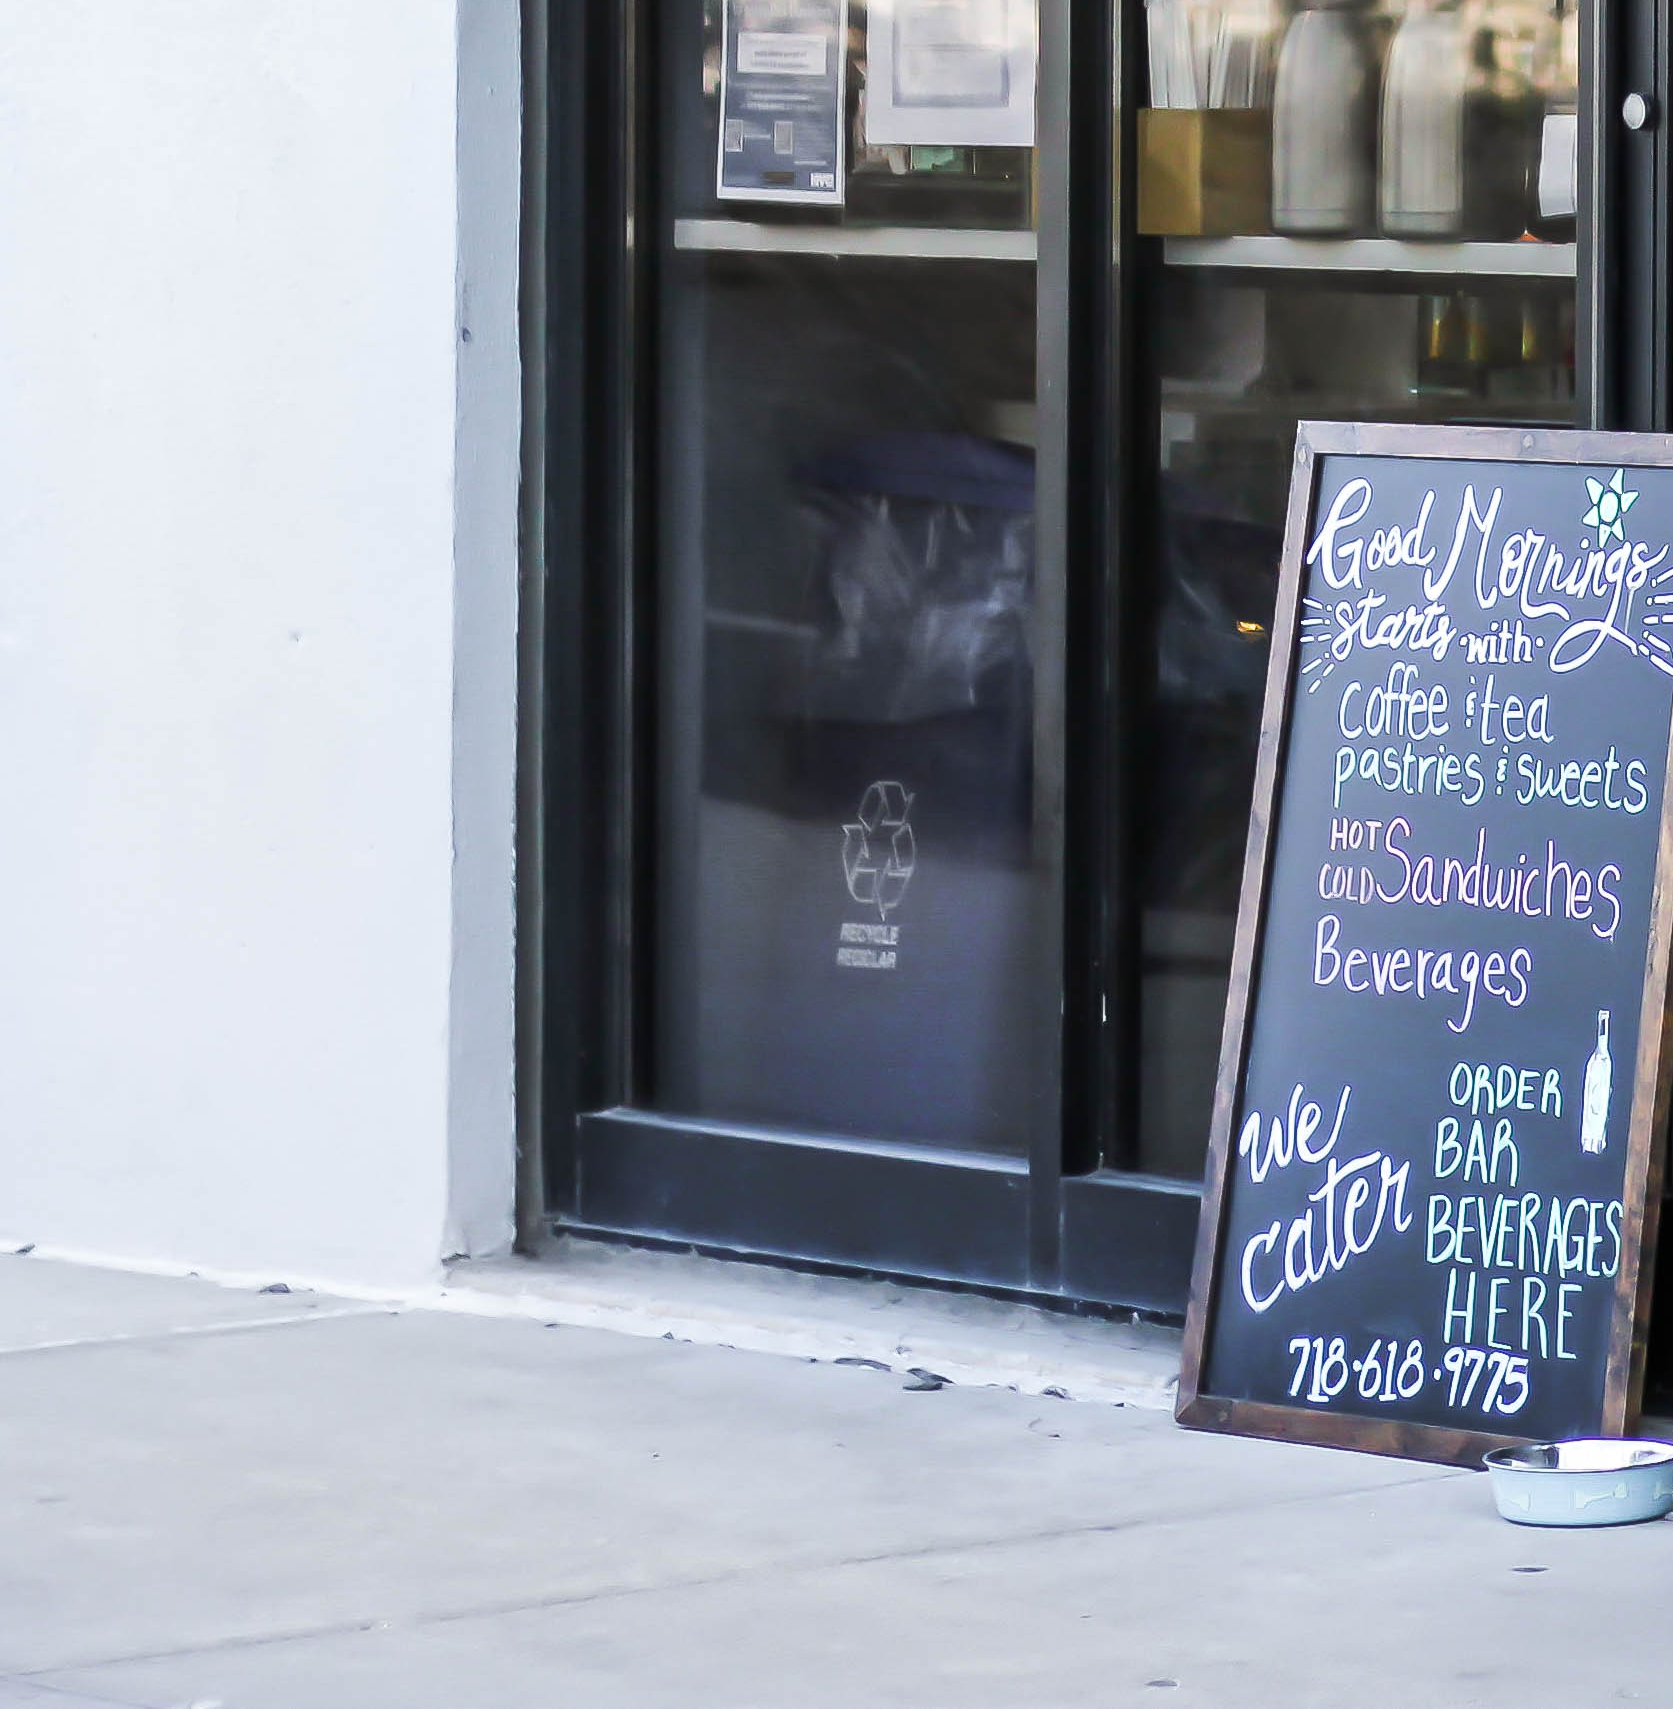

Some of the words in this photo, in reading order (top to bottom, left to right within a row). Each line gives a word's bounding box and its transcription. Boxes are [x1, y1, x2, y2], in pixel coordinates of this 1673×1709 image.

[1307, 478, 1436, 590] Good
[1424, 485, 1671, 673] Mornings
[1481, 675, 1553, 746] tea
[1333, 745, 1485, 808] pastries
[1517, 746, 1648, 814] sweets
[1330, 817, 1383, 852] HOT
[1318, 863, 1373, 904] COLD
[1376, 816, 1621, 940] Sandwiches
[1314, 914, 1532, 1033] Beverages
[1449, 1062, 1562, 1118] ORDER
[1435, 1116, 1518, 1187] BAR
[1241, 1150, 1413, 1313] cater
[1425, 1192, 1624, 1278] BEVERAGES
[1443, 1267, 1582, 1360] HERE
